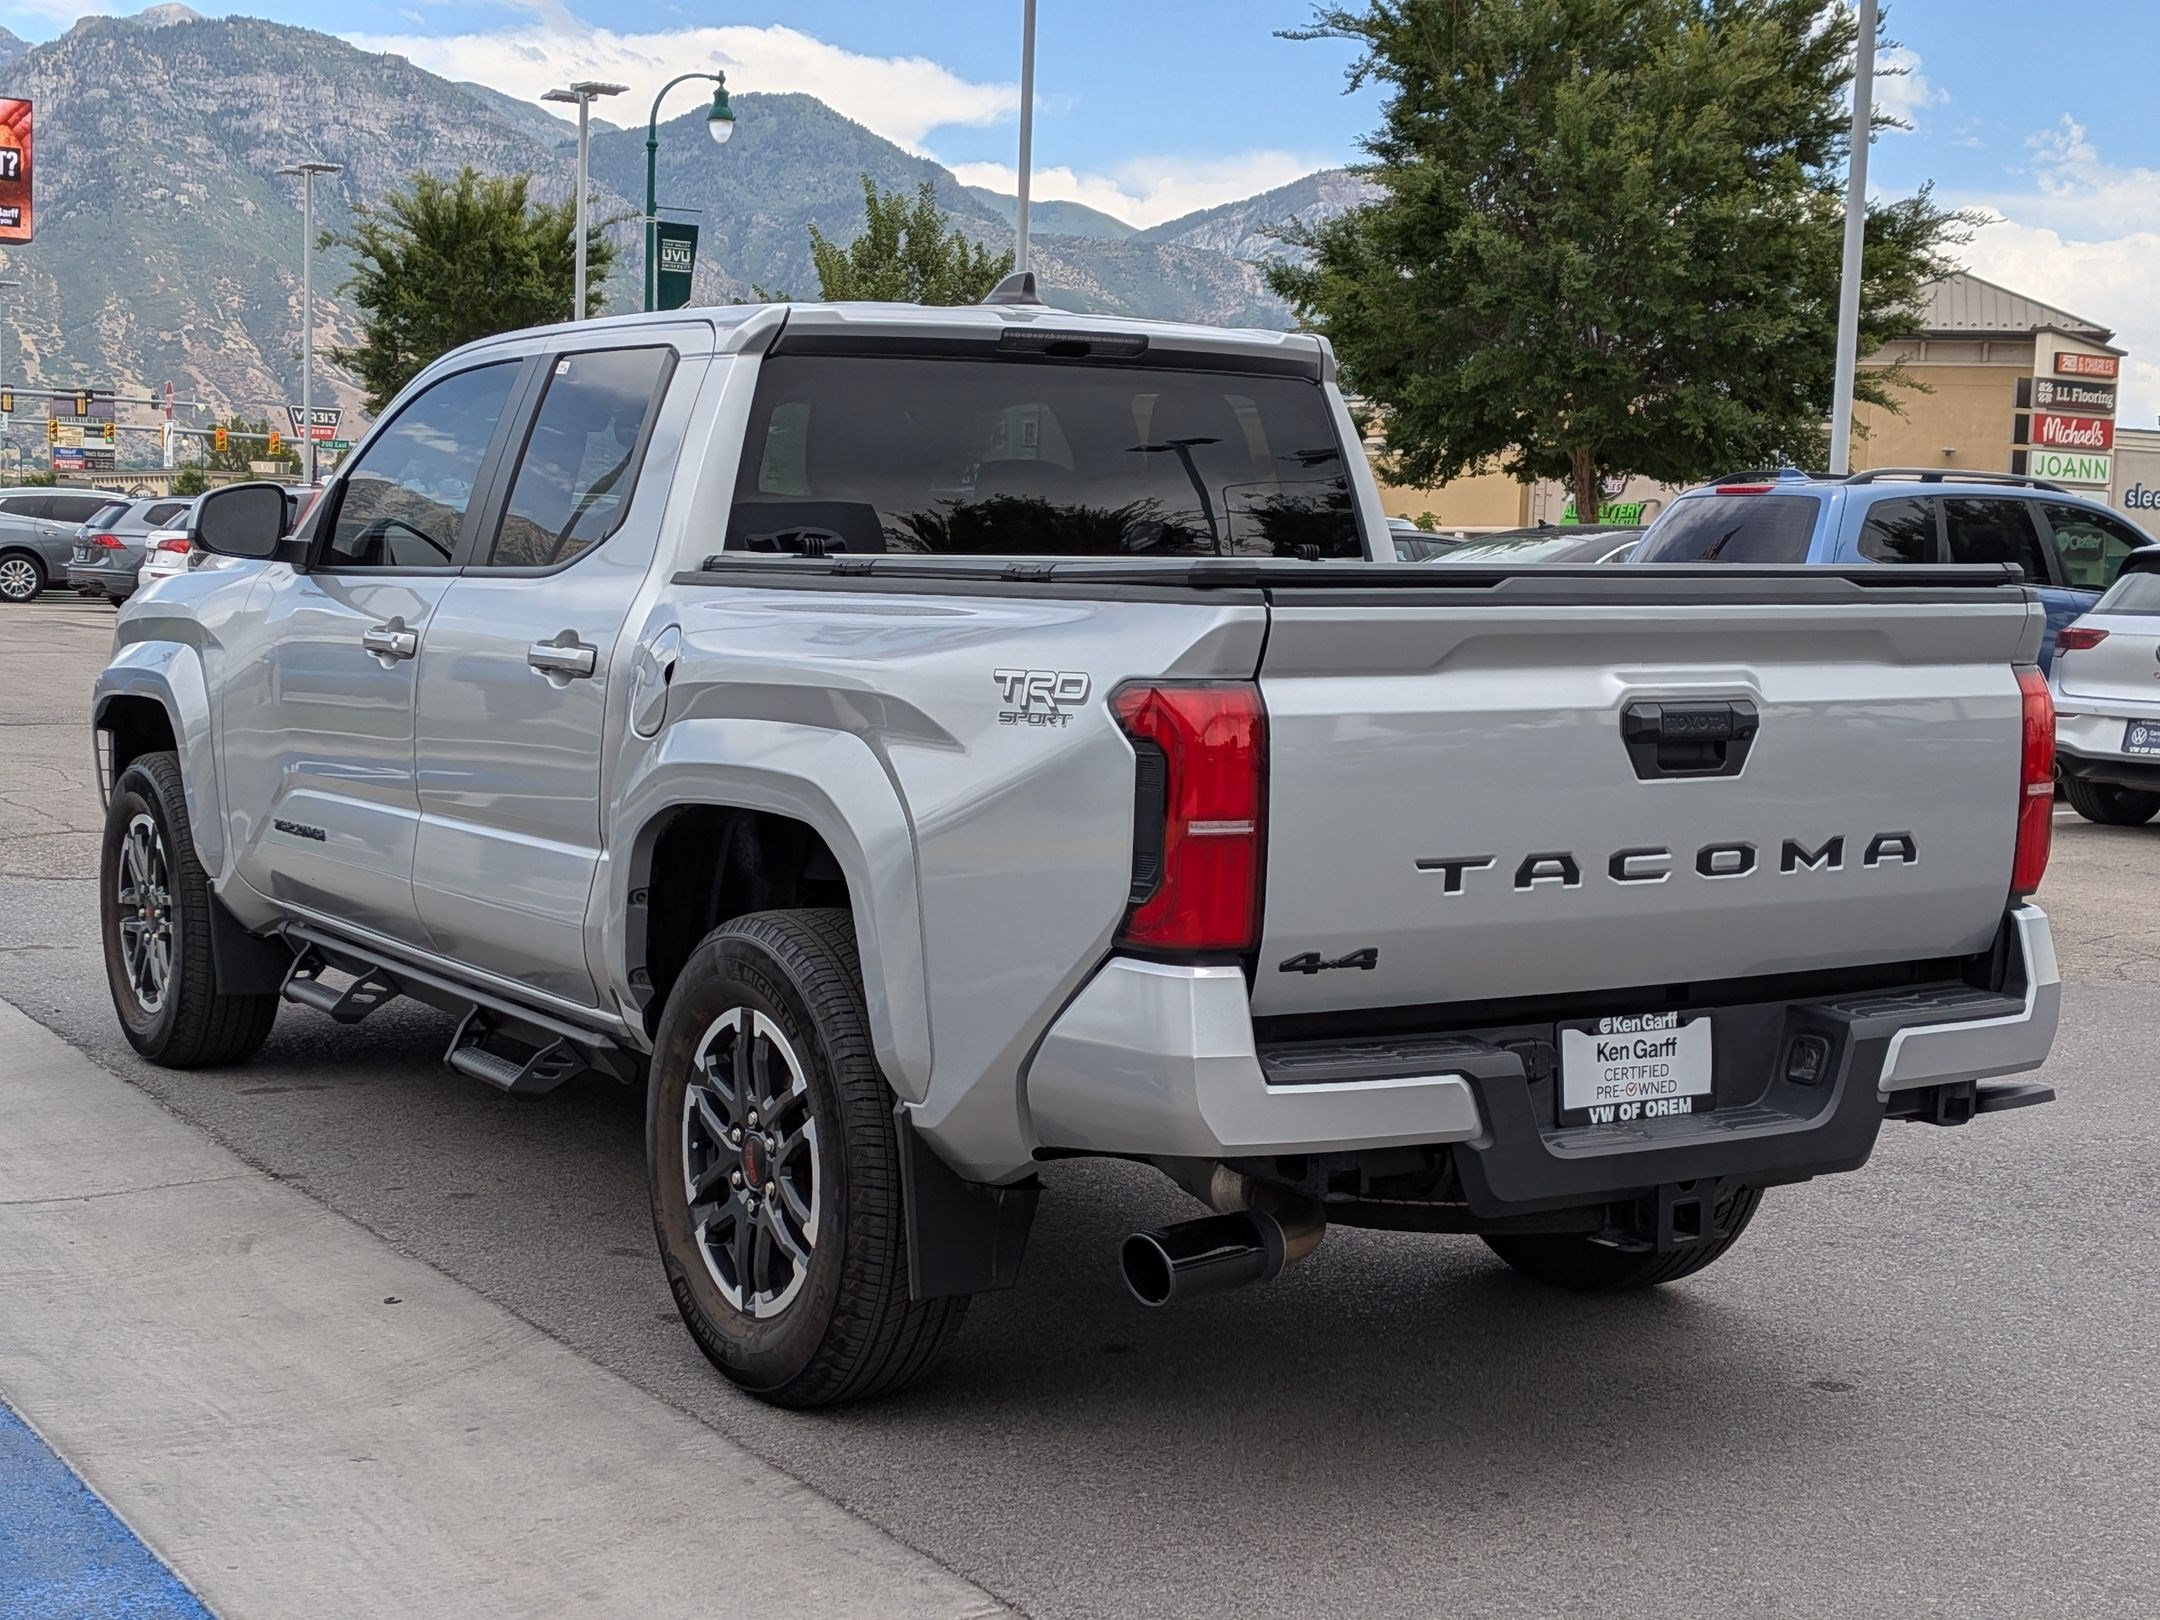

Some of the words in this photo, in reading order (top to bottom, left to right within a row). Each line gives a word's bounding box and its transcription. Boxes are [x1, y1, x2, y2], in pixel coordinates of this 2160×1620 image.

[662, 249, 691, 263] UVU
[2055, 386, 2071, 402] LL
[2072, 388, 2114, 408] Flooring
[2043, 416, 2104, 446] Michaels
[2035, 455, 2108, 480] JOANN
[993, 668, 1093, 712] TRD
[998, 711, 1074, 728] SPORT
[1415, 830, 1919, 896] TACOMA
[740, 967, 800, 1042] MICHELIN
[1612, 1015, 1642, 1034] Ken
[1642, 1010, 1679, 1031] Garff
[1596, 1041, 1630, 1063] Ken
[1633, 1037, 1678, 1059] Garff
[1604, 1063, 1670, 1082] CERTIFIED
[1588, 1105, 1615, 1124] VW
[1619, 1101, 1642, 1121] OF
[1645, 1096, 1693, 1118] OREM
